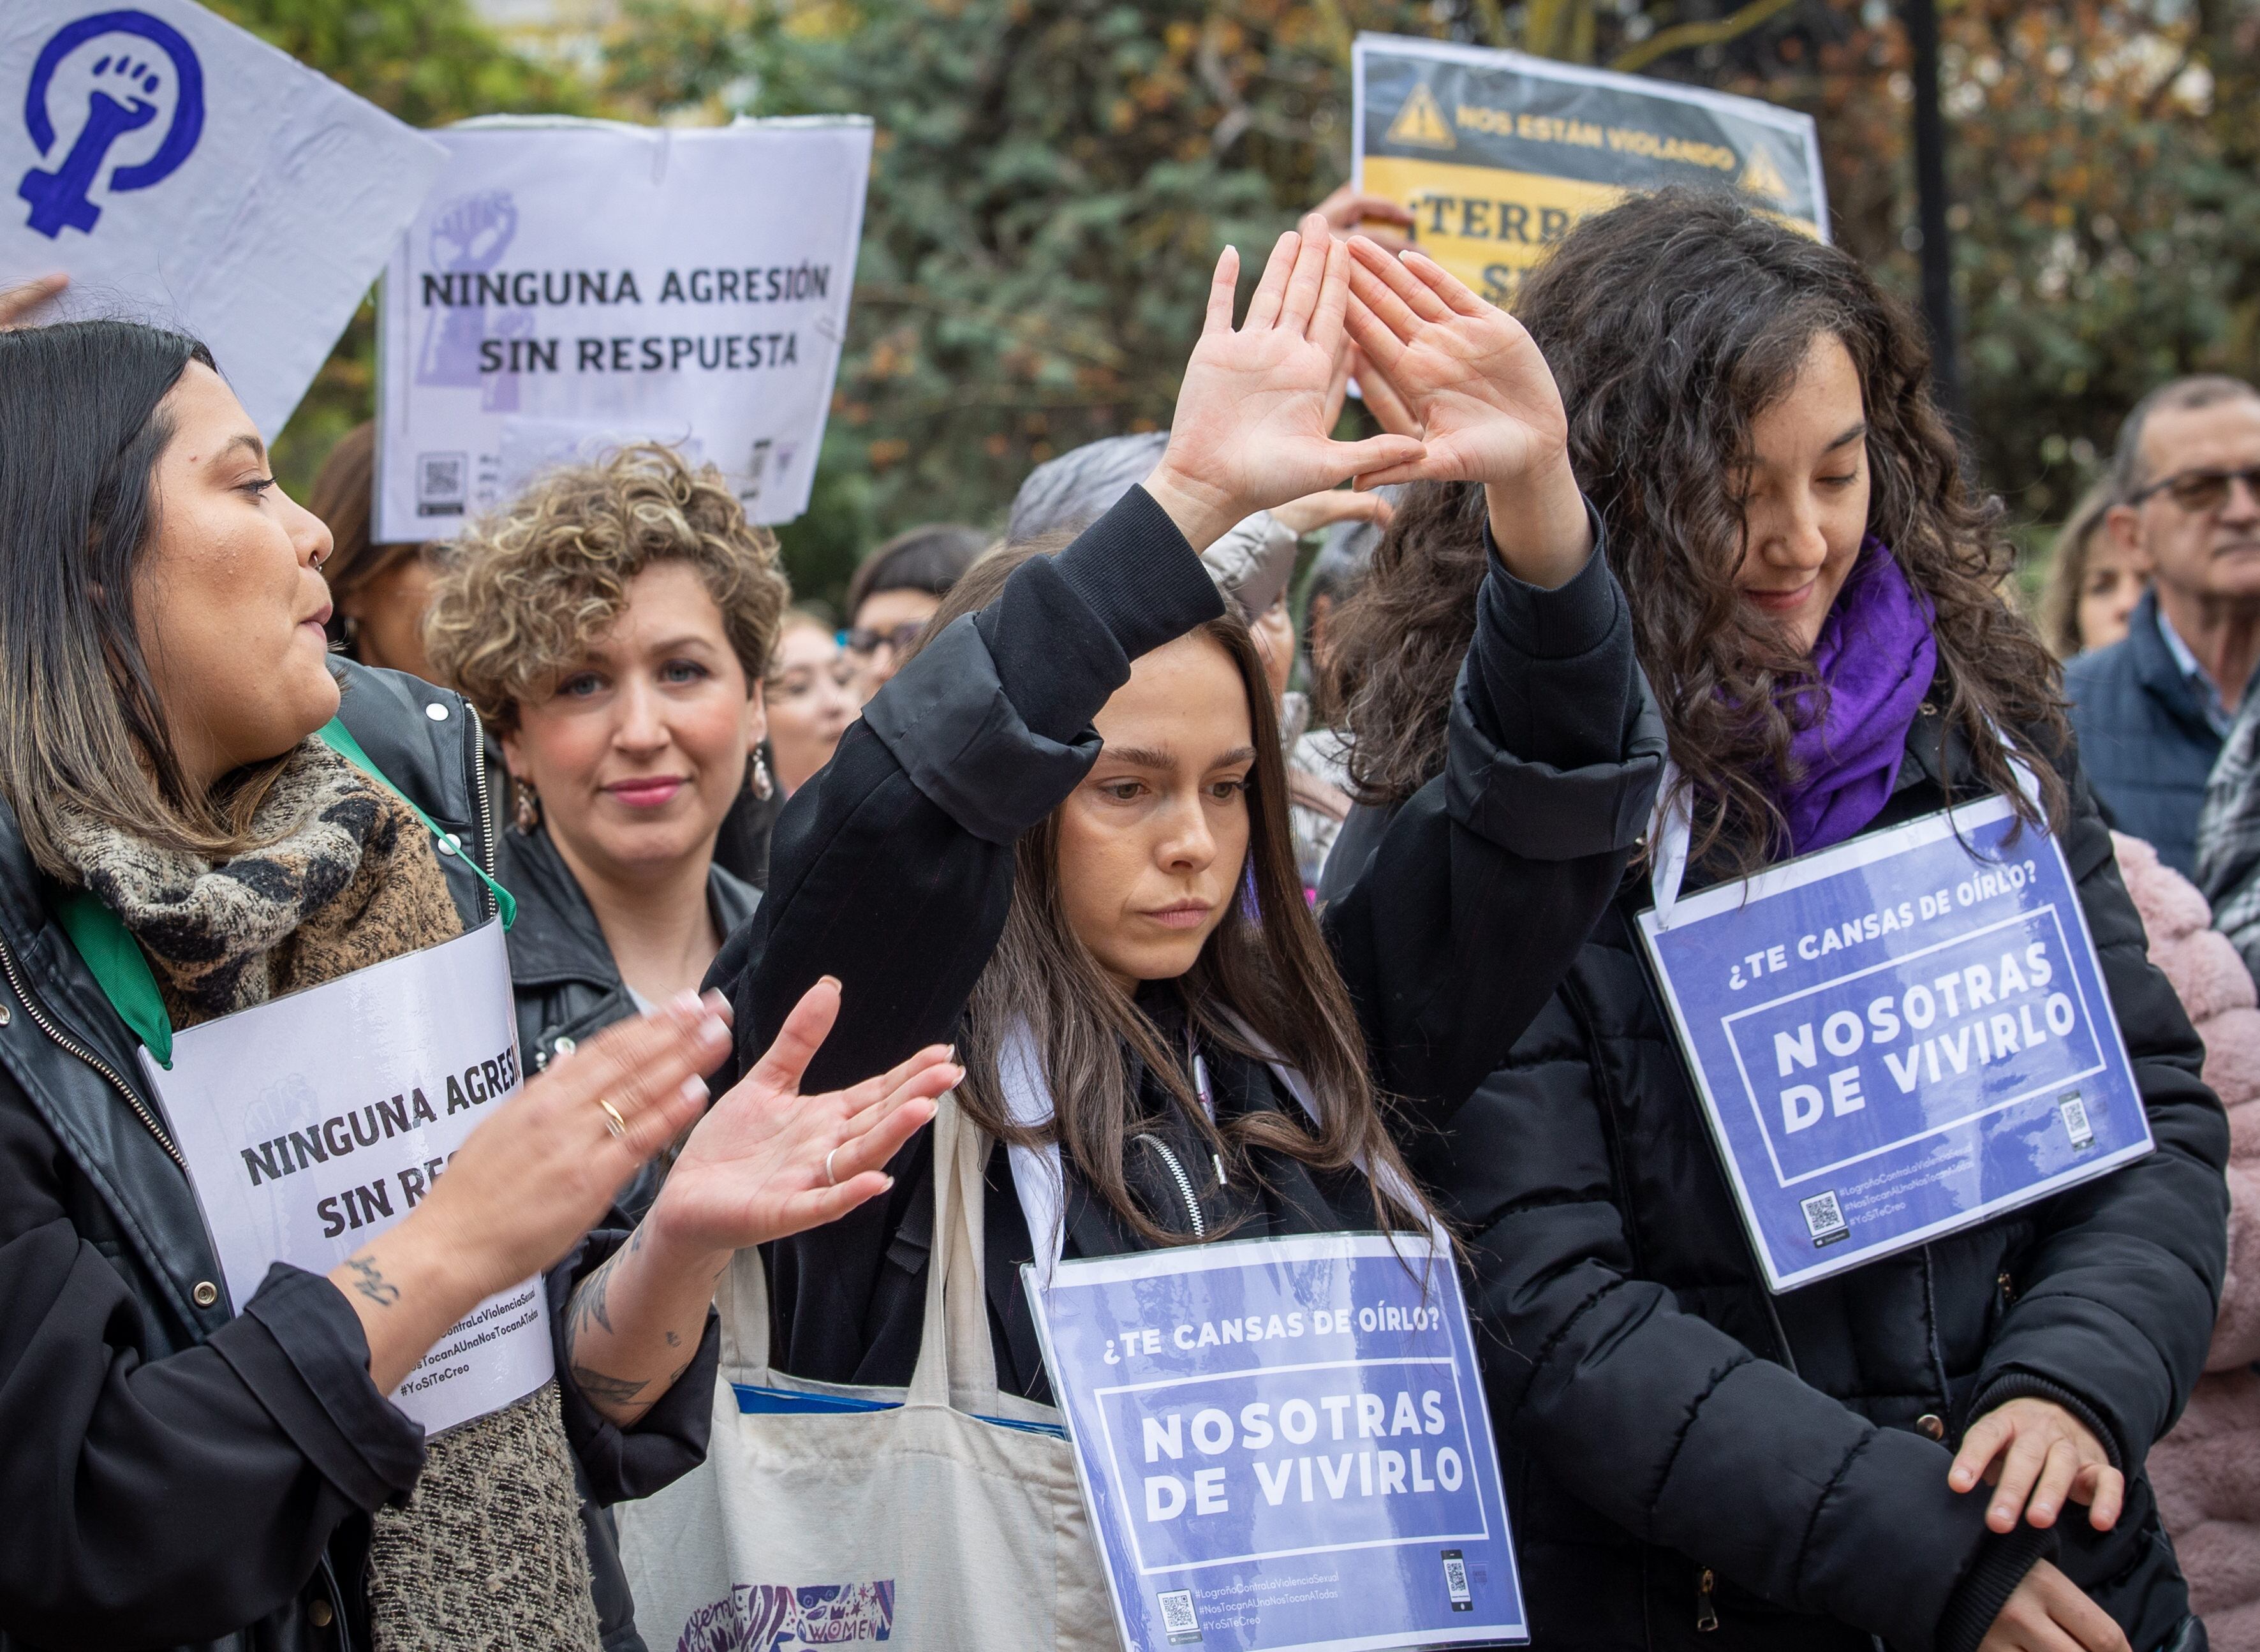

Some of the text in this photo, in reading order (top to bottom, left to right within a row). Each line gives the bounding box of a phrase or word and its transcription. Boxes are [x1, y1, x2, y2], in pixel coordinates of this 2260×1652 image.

[1456, 104, 1737, 172] NOS ESTÁN VIOLANDO
[422, 257, 831, 306] NINGUNA AGRESIÓN
[478, 332, 797, 373] SIN RESPUESTA
[1729, 860, 2037, 990] ¿TE CANSAS DE OÍRLO?
[1774, 941, 2053, 1077] NOSOTRAS
[1780, 992, 2075, 1134] DE VIVIRLO
[240, 1087, 438, 1186] NINGUNA
[316, 1178, 394, 1238] SIN
[1104, 1300, 1440, 1365] ¿TE CANSAS DE OÍRLO?
[1142, 1389, 1445, 1463] NOSOTRAS
[1145, 1446, 1463, 1523] DE VIVIRLO
[1195, 1571, 1339, 1600] #LogroñoContraLaViolenciaSexual
[1199, 1589, 1338, 1615] #NosTocanAUnaNosTocanATodas
[808, 1620, 876, 1641] WOMEN
